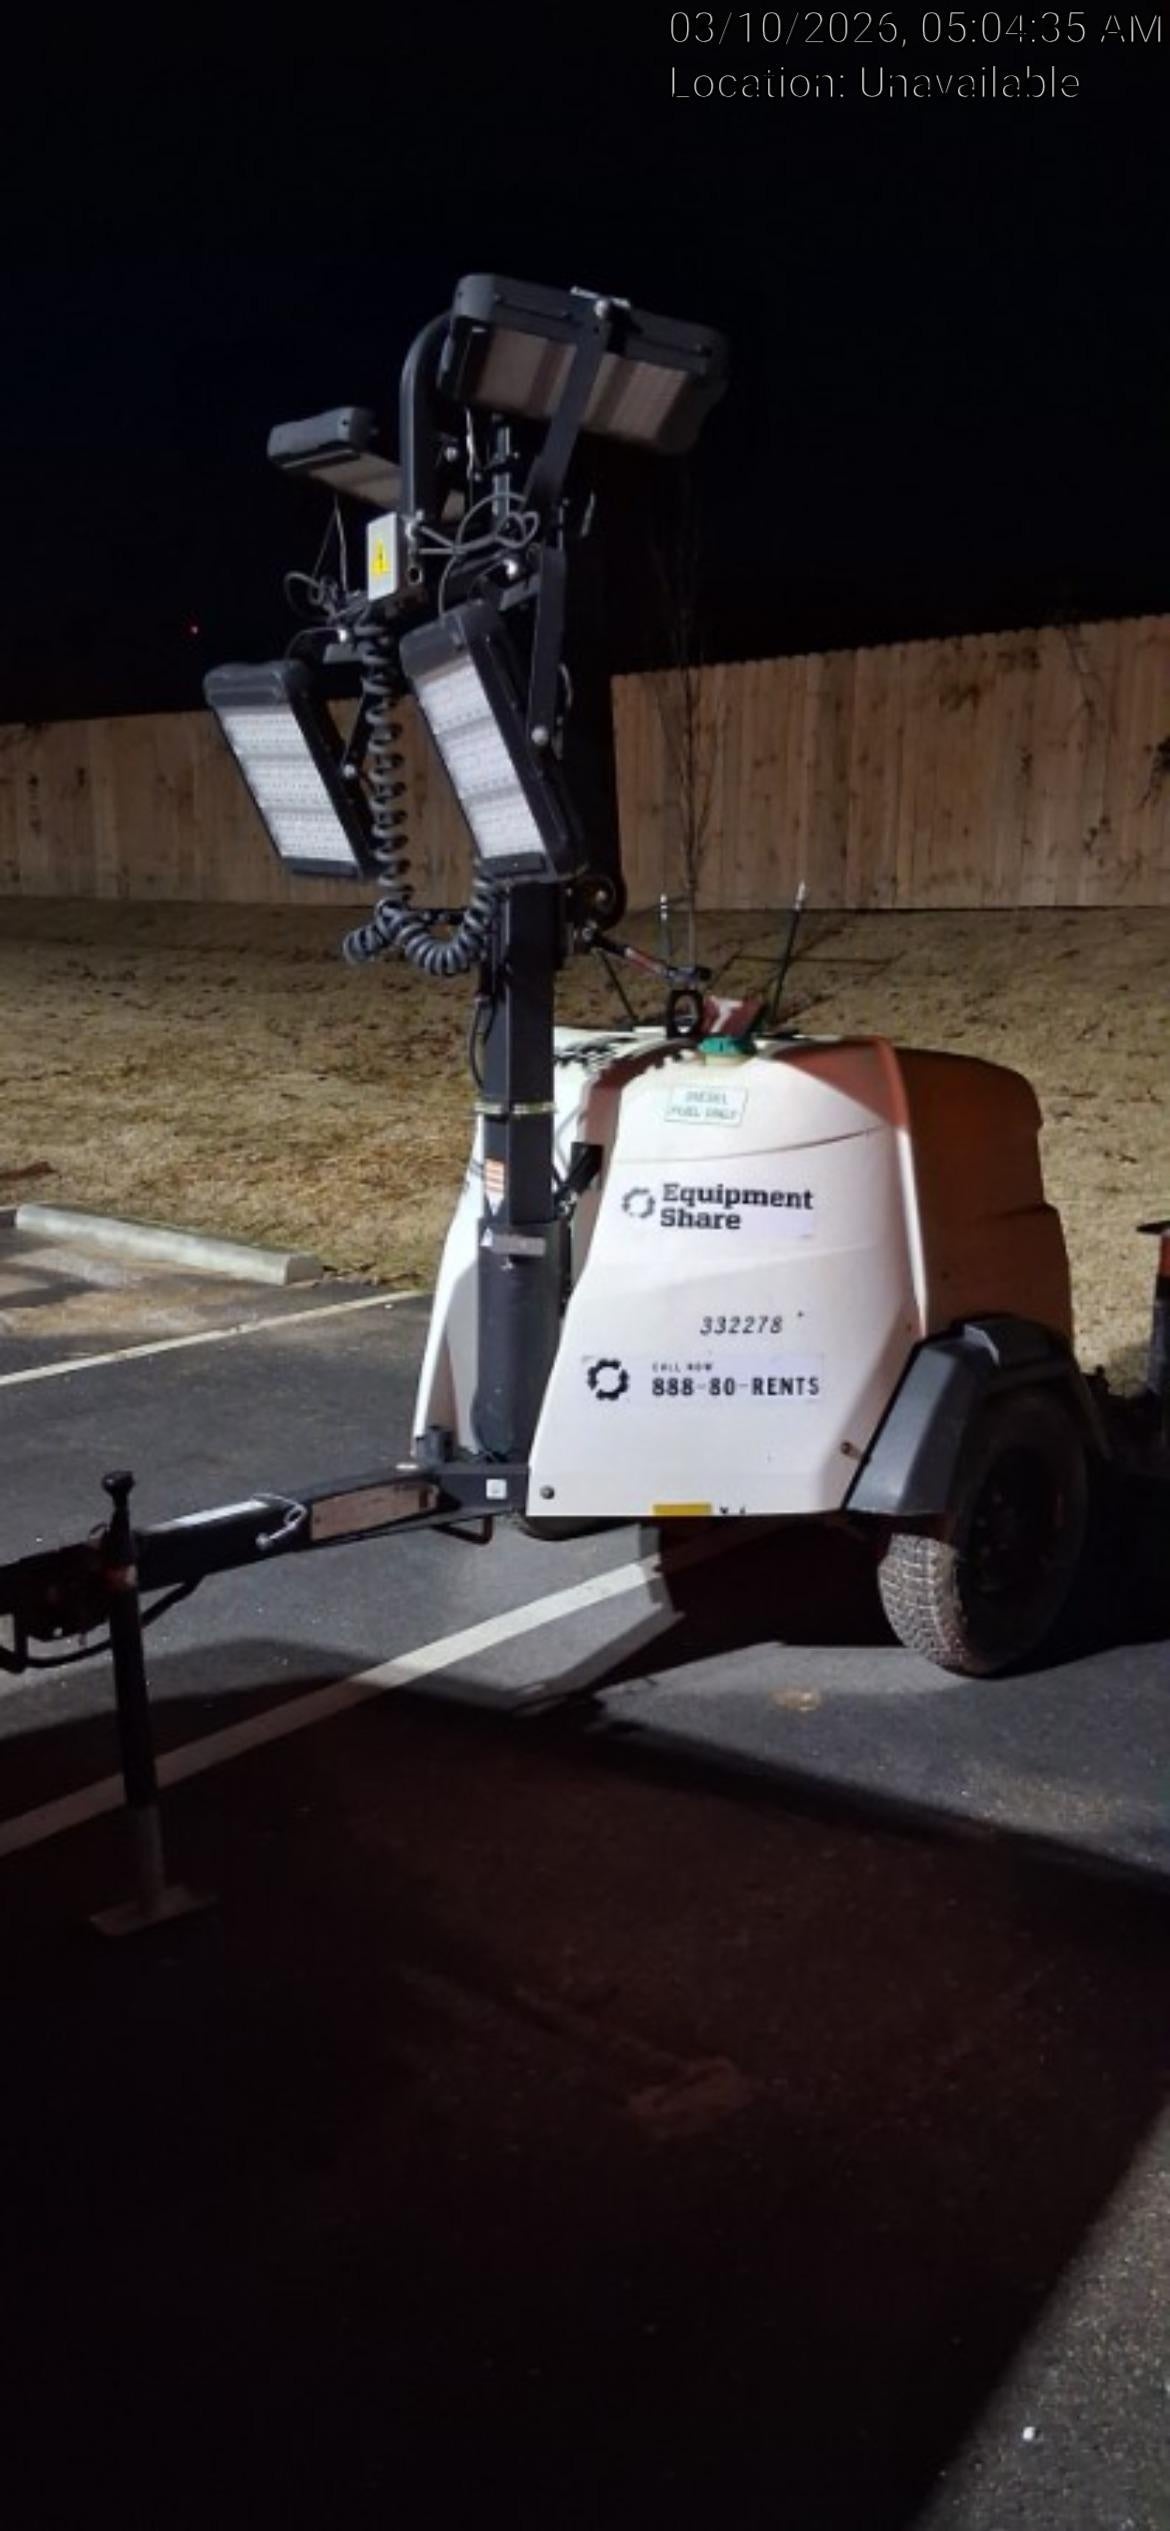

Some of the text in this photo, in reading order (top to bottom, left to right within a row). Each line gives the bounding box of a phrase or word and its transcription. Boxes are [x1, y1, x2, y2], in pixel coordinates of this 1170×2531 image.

[662, 1183, 814, 1211] Equipment
[660, 1207, 741, 1230] Share
[699, 1315, 783, 1335] 332278
[651, 1376, 820, 1397] 888-80-RENTS
